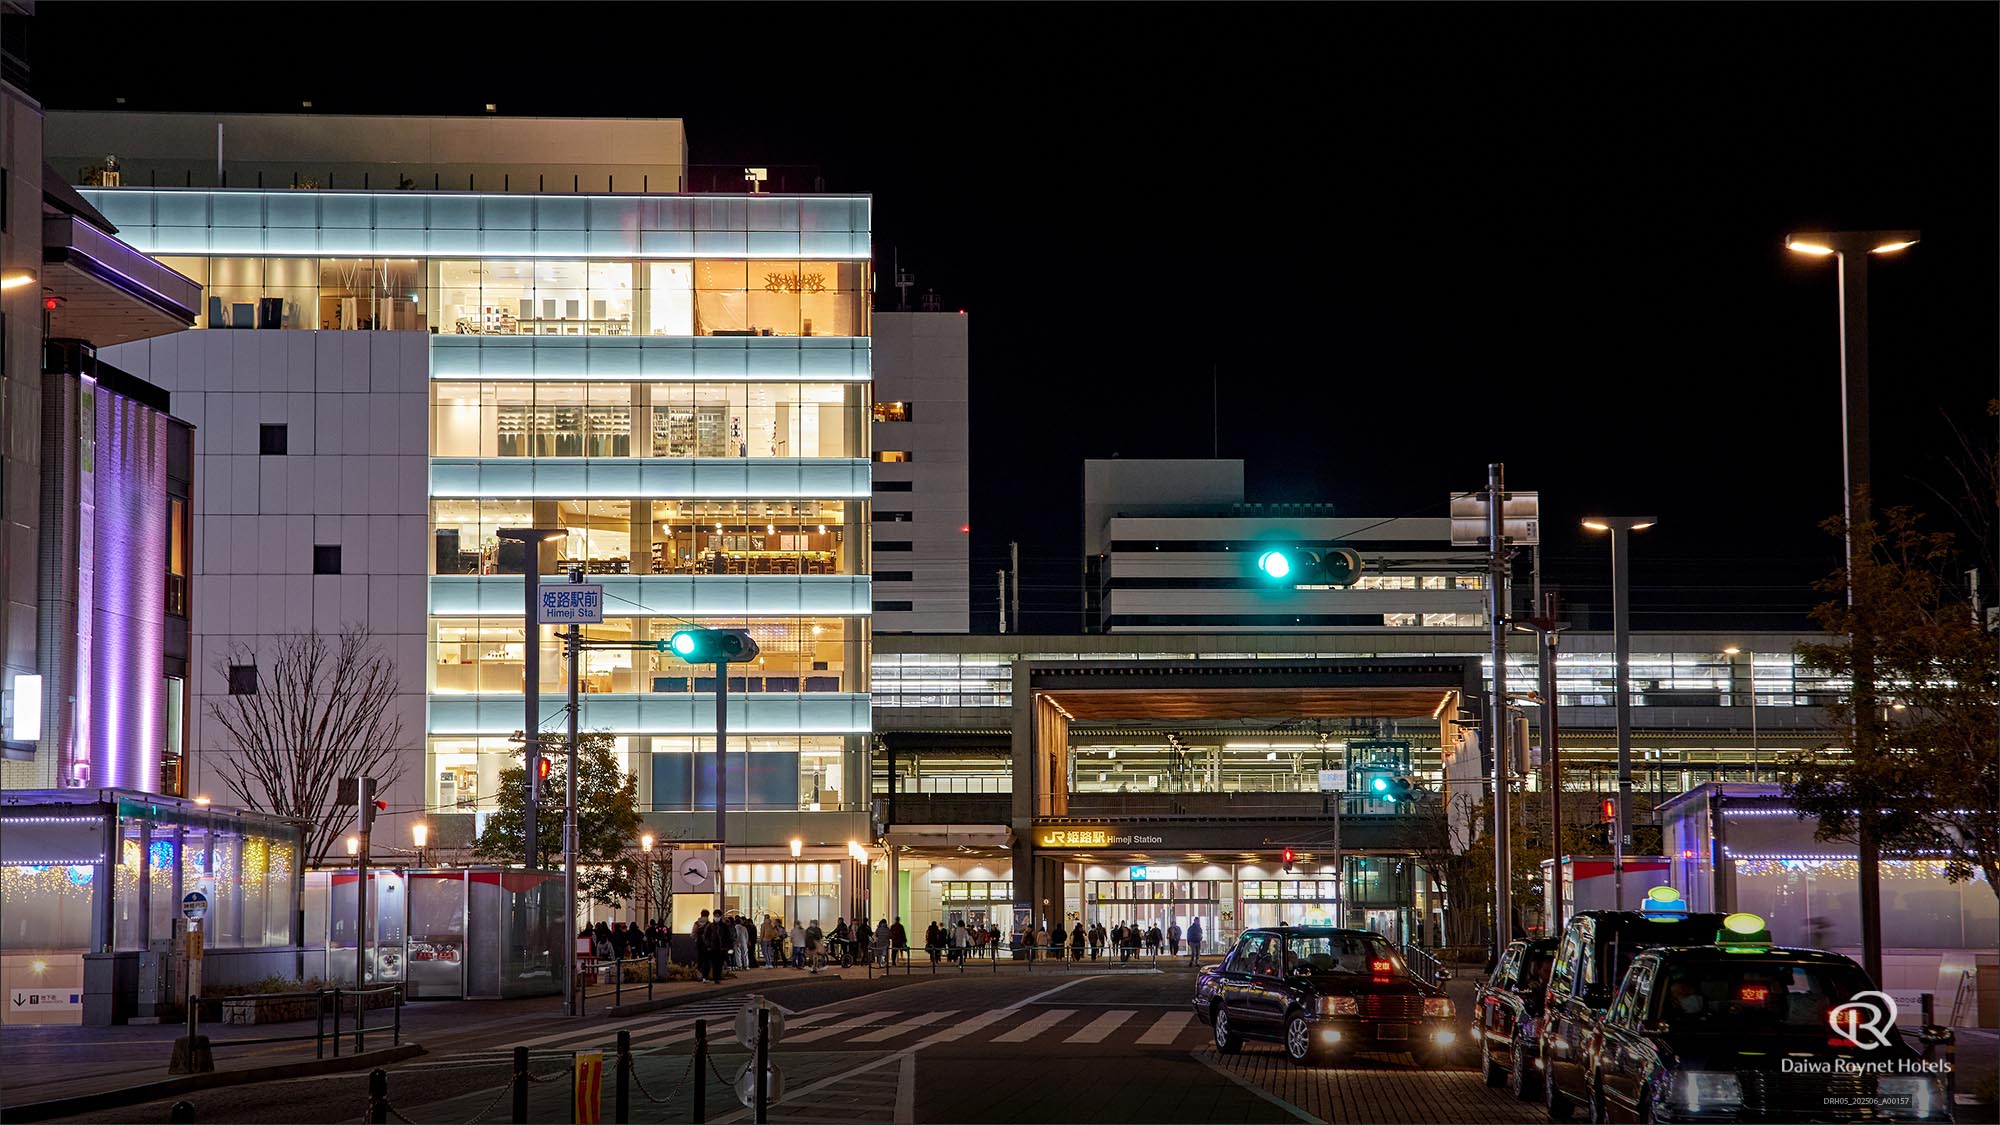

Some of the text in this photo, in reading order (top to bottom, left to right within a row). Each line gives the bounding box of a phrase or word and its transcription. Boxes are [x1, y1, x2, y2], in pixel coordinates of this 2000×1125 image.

[543, 590, 598, 608] 姫路駅前
[546, 608, 596, 619] Himeji Sta.
[1044, 831, 1162, 845] JR 姫路駅 Himeji Station
